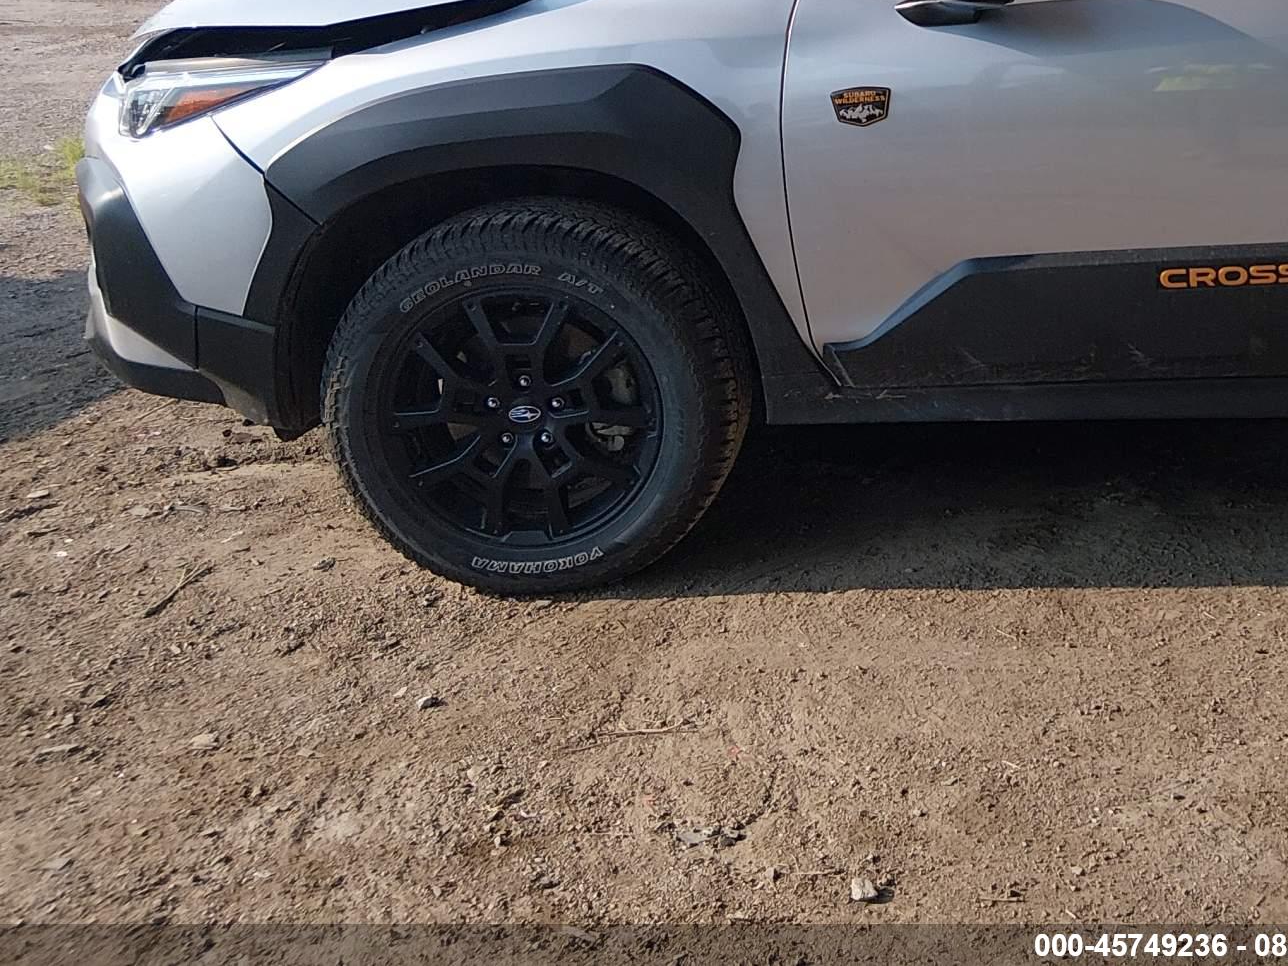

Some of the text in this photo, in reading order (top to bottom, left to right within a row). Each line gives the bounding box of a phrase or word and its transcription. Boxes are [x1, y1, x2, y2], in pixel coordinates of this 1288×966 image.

[399, 263, 604, 313] GEOLANDAR A/T
[471, 545, 605, 575] YOKOHAMA
